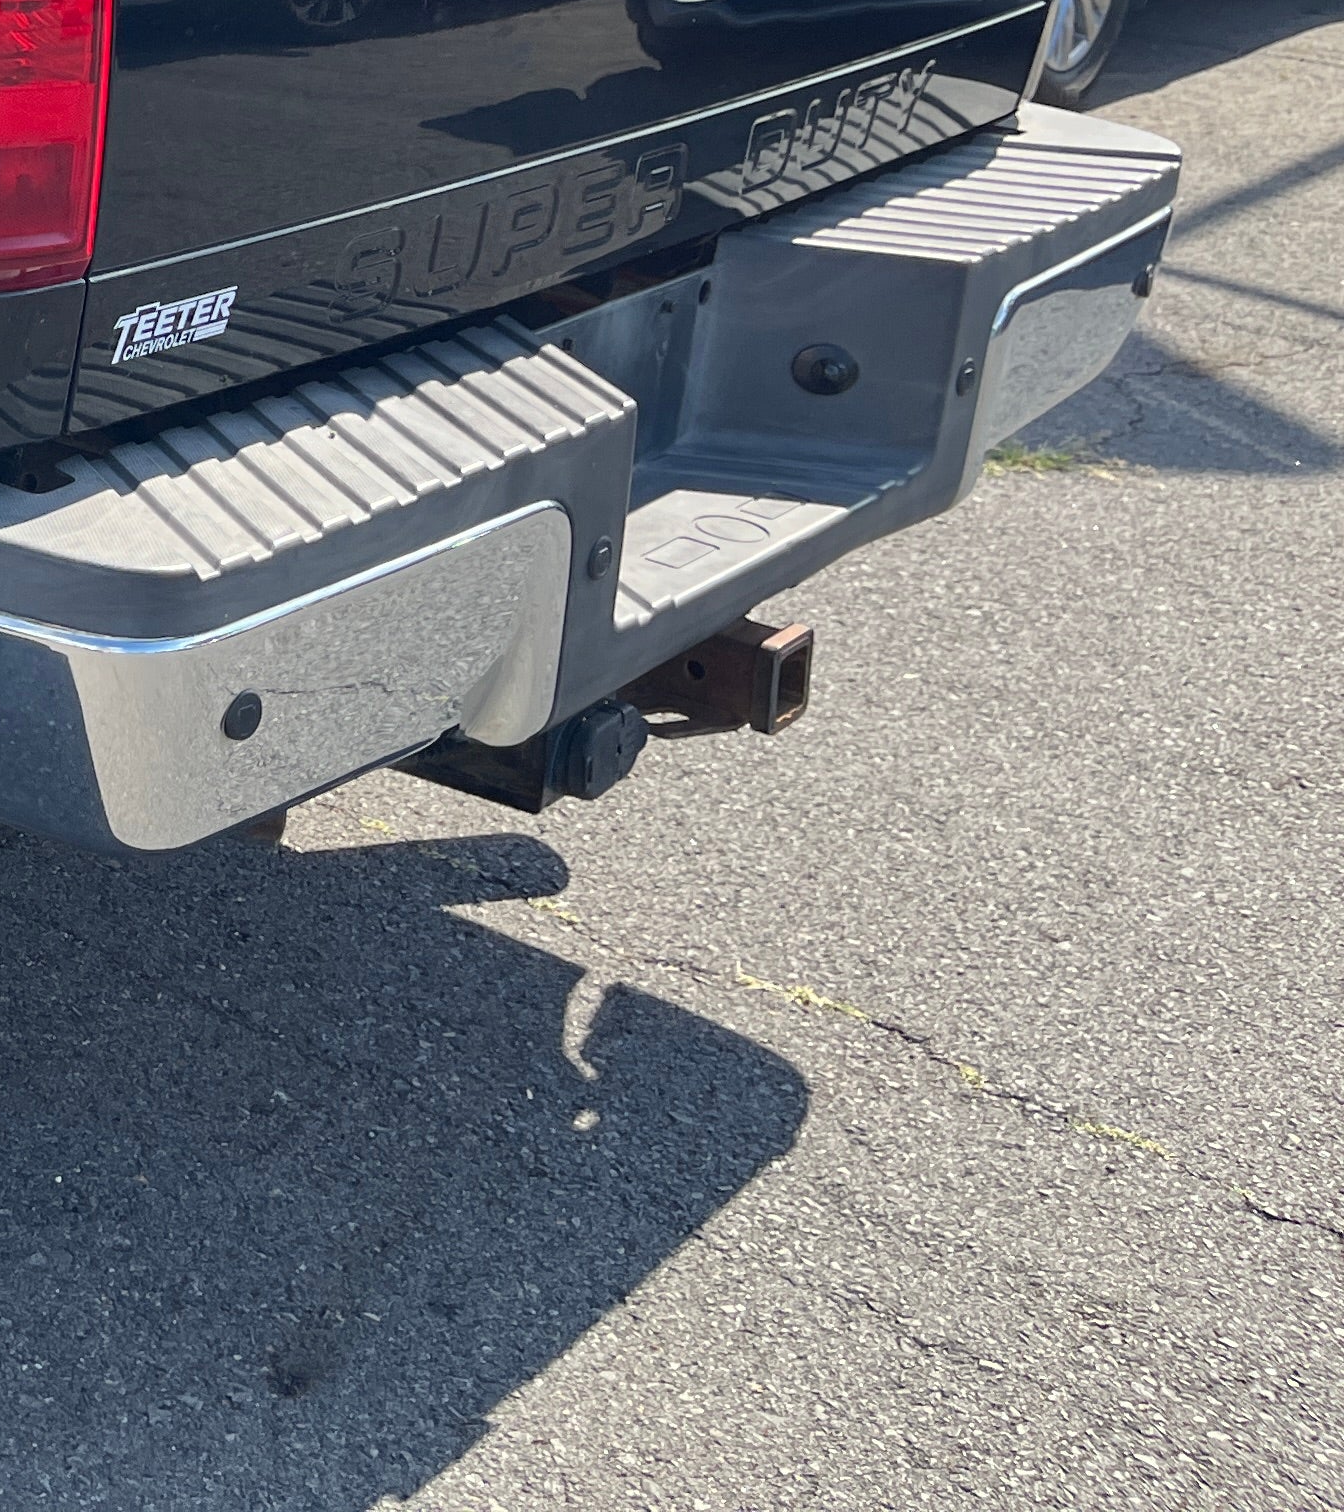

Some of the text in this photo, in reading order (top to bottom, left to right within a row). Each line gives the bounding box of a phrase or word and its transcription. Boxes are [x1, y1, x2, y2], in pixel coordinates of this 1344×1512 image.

[738, 58, 936, 196] DUTY
[327, 143, 684, 324] SUPER
[111, 290, 238, 365] TEETER
[123, 328, 196, 361] CHEVROLET
